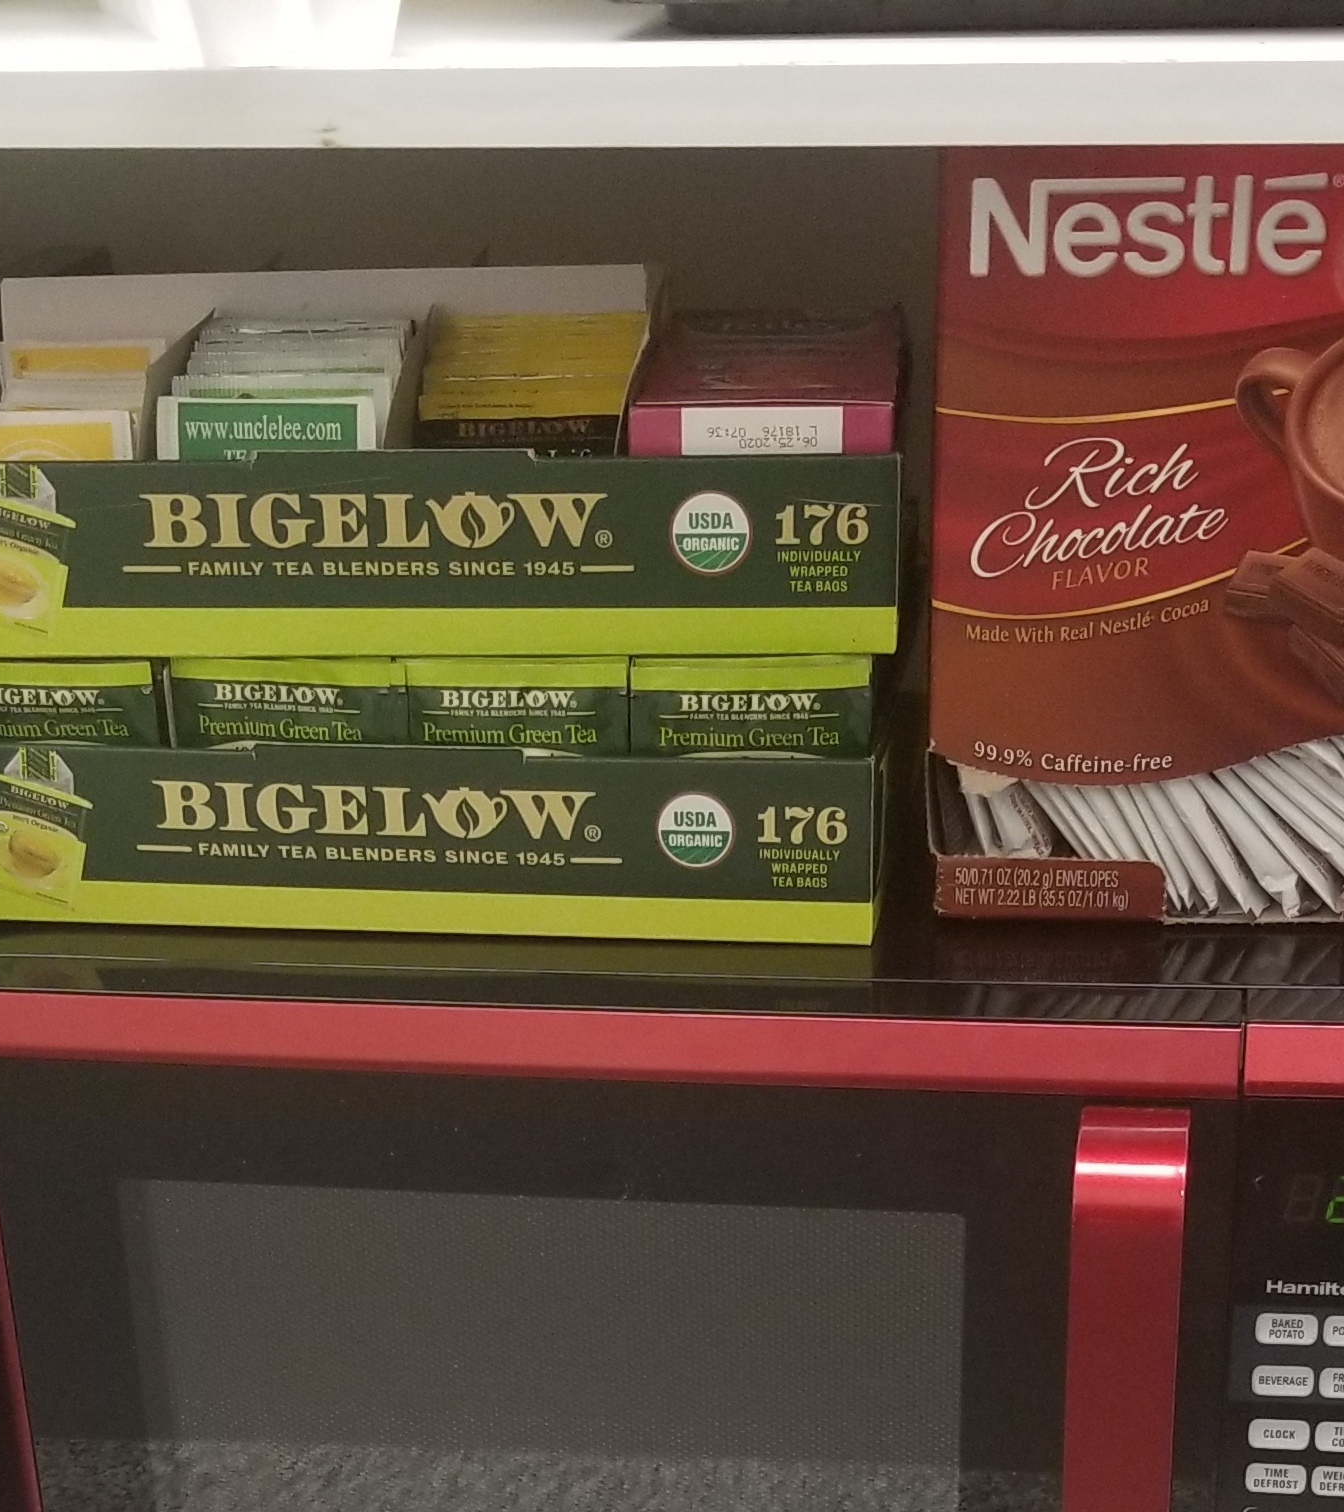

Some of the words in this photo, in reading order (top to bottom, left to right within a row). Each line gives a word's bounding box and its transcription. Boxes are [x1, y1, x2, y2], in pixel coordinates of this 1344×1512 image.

[970, 172, 1330, 278] Nestlé
[185, 414, 341, 441] www.unclelee.com
[457, 418, 592, 438] BIGELOW
[707, 427, 746, 438] 07:36
[739, 436, 818, 449] 06.25.2020
[1025, 436, 1199, 510] Rich
[140, 492, 607, 550] BIGELOW
[688, 512, 733, 530] USDA
[774, 504, 869, 545] 176
[682, 536, 740, 552] ORGANIC
[970, 502, 1230, 577] Chocolate
[776, 550, 861, 563] INDIVIDUALLY
[188, 561, 263, 576] FAMILY
[272, 561, 314, 576] TEA
[322, 561, 439, 576] BLENDERS
[448, 561, 515, 576] SINCE
[523, 561, 575, 576] 1945
[790, 565, 848, 578] WRAPPED
[1050, 556, 1150, 591] FLAVOR
[790, 580, 811, 593] TEA
[814, 580, 848, 593] BAGS
[966, 624, 1009, 642] Made
[1015, 627, 1054, 643] With
[1060, 622, 1094, 642] Real
[1099, 609, 1151, 636] Nestlé
[1161, 599, 1209, 623] Cocoa
[214, 682, 340, 706] BIGELOW
[440, 690, 574, 709] BIGELOW
[679, 693, 818, 712] BIGELOW
[44, 719, 97, 737] Green
[98, 719, 129, 738] Tea
[199, 714, 276, 738] Premium
[279, 718, 329, 740] Green
[332, 721, 363, 742] Tea
[423, 722, 506, 744] Premium
[508, 724, 563, 744] Green
[565, 724, 597, 744] Tea
[660, 726, 745, 747] Premium
[749, 728, 804, 746] Green
[806, 727, 840, 746] Tea
[973, 740, 1033, 769] 99.9%
[1041, 750, 1173, 775] Caffeine-free
[10, 784, 70, 810] BIGELOW
[153, 779, 596, 840] BIGELOW
[674, 811, 717, 828] USDA
[757, 807, 847, 845] 176
[668, 832, 722, 848] ORGANIC
[198, 843, 269, 858] FAMILY
[278, 845, 317, 860] TEA
[324, 846, 436, 863] BLENDERS
[445, 849, 508, 865] SINCE
[516, 852, 565, 867] 1945
[759, 848, 840, 861] INDIVIDUALLY
[771, 863, 828, 876] WRAPPED
[954, 867, 993, 886] 50/0.71
[997, 869, 1011, 885] OZ
[1013, 867, 1040, 887] (20.2
[1042, 867, 1054, 889] g)
[1056, 870, 1118, 888] ENVELOPES
[771, 876, 793, 889] TEA
[796, 876, 828, 889] BAGS
[955, 888, 976, 905] NET
[977, 889, 995, 905] WT
[997, 889, 1020, 906] 2.22
[1022, 890, 1036, 906] LB
[1039, 889, 1065, 907] (35.5
[1113, 890, 1129, 911] kg)
[1271, 1318, 1304, 1329] BAKED
[1268, 1329, 1305, 1340] POTATO
[1258, 1375, 1309, 1387] BEVERAGE
[1263, 1429, 1296, 1440] CLOCK
[1264, 1468, 1289, 1478] TIME
[1253, 1479, 1299, 1490] DEFROST
